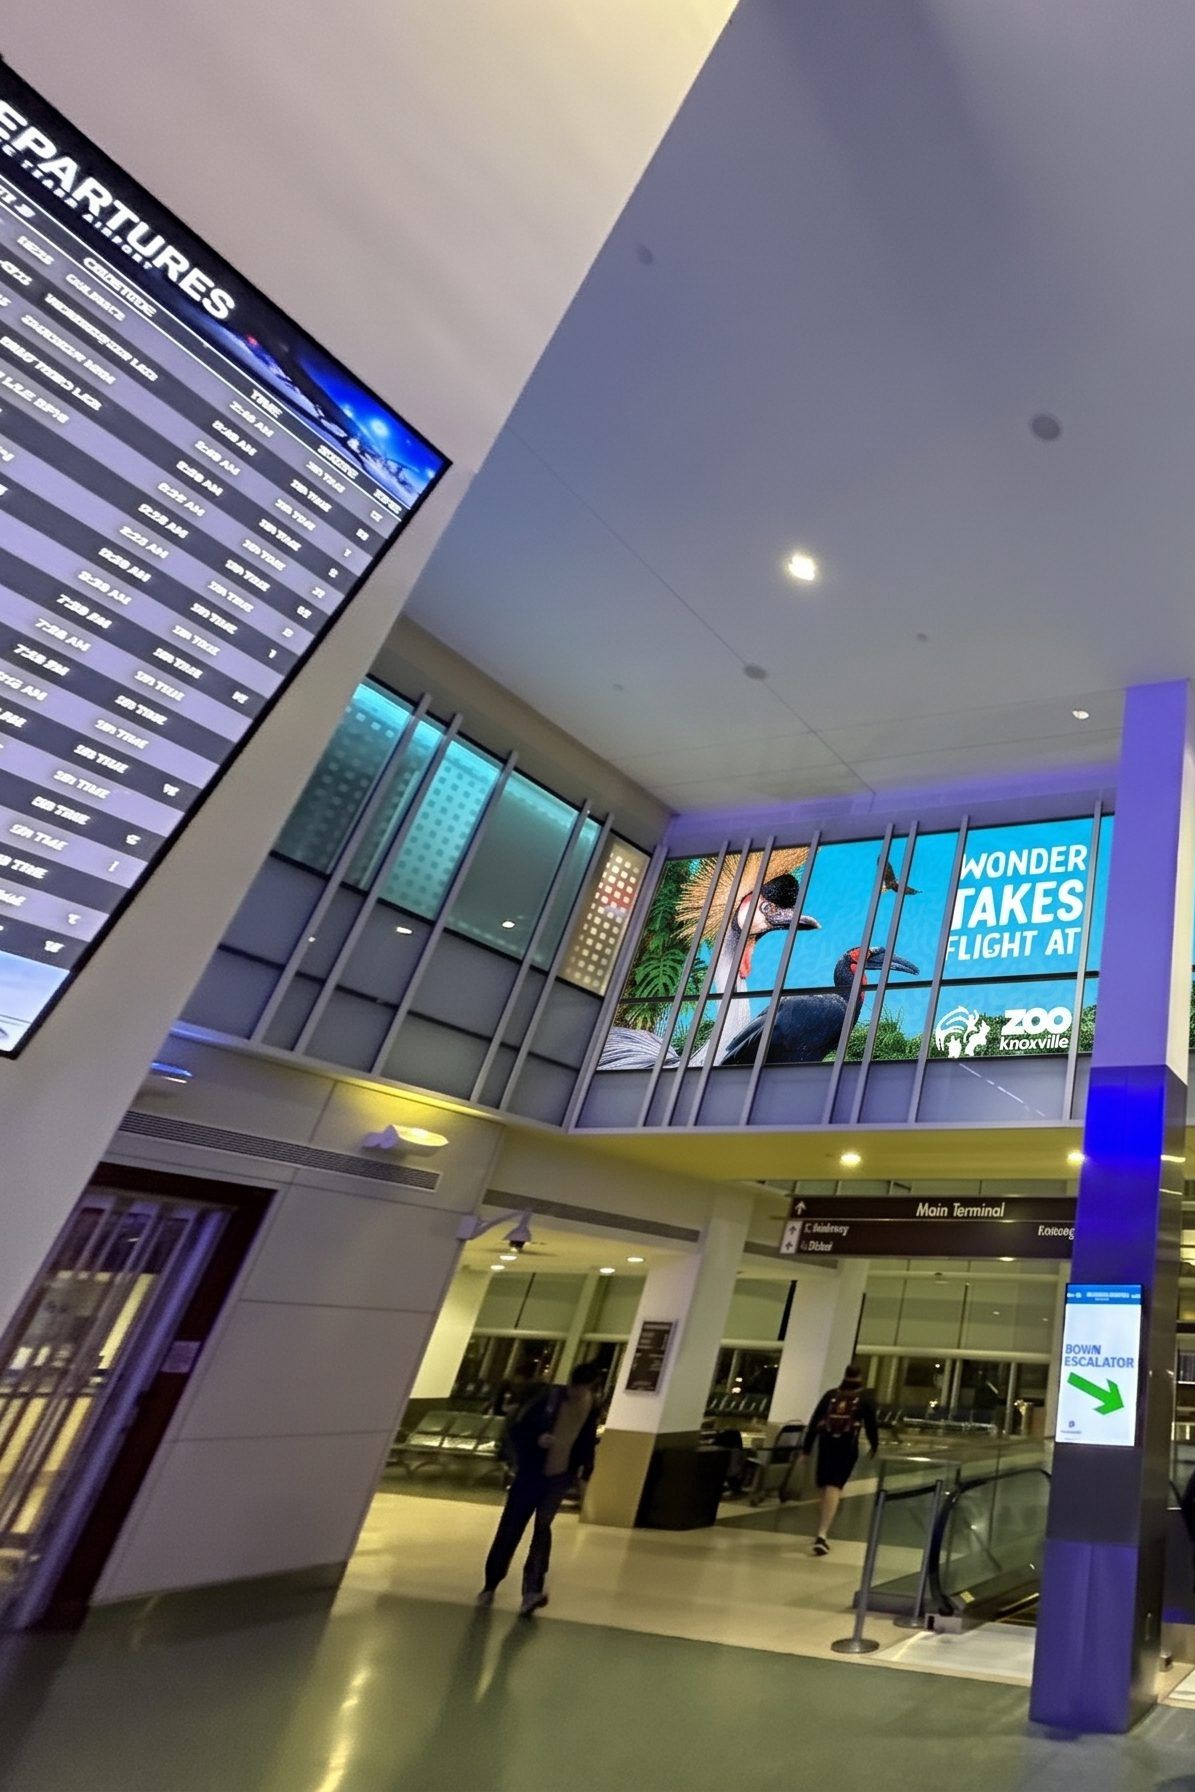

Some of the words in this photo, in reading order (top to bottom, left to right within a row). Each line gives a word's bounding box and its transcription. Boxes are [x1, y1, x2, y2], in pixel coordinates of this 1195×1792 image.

[960, 844, 1088, 880] WONDER
[951, 878, 1085, 931] TAKES
[946, 930, 1038, 961] FLIGHT
[1044, 927, 1082, 956] AT
[1000, 1034, 1069, 1051] knoxville
[916, 1202, 948, 1217] Main
[953, 1201, 1005, 1217] Terminal
[1064, 1356, 1134, 1369] ESCALATOR
